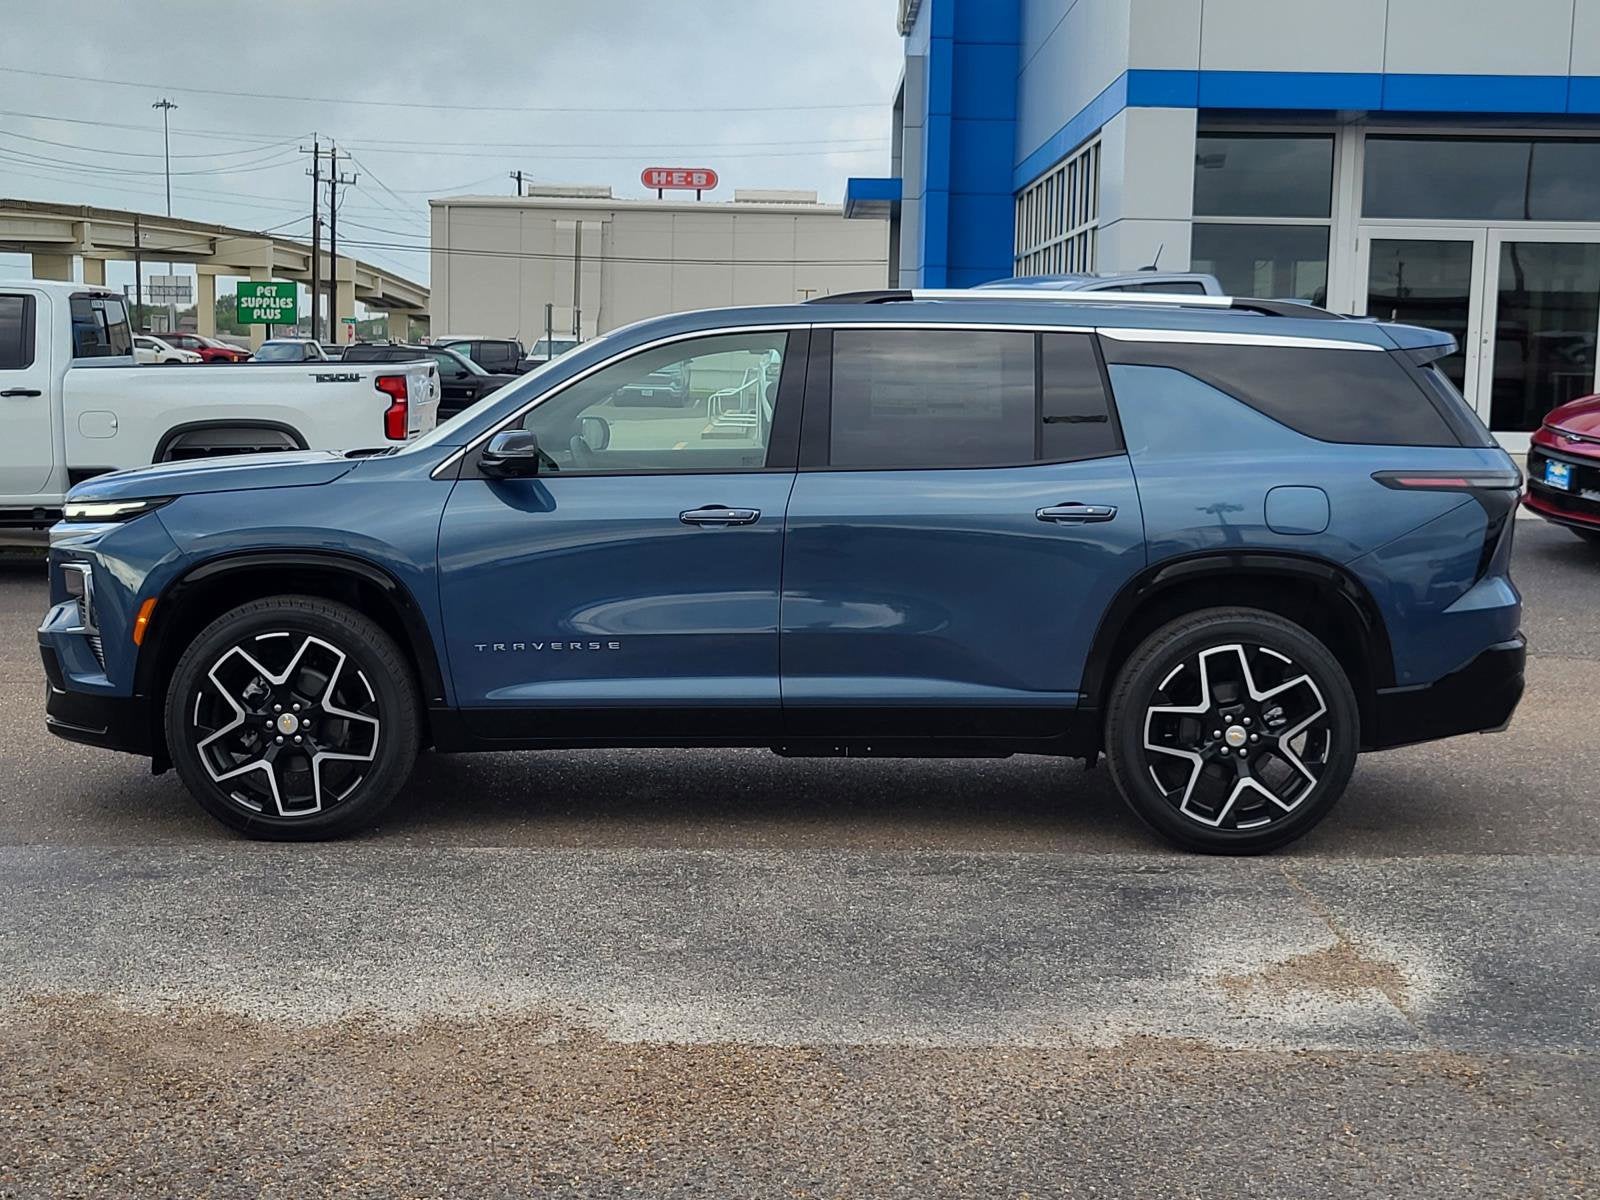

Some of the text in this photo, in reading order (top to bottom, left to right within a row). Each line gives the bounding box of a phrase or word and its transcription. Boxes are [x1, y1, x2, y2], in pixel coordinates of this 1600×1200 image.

[256, 286, 277, 296] PET
[241, 297, 293, 308] SUPPLIES
[253, 309, 281, 319] PLUS
[474, 642, 621, 651] TRAVERSE
